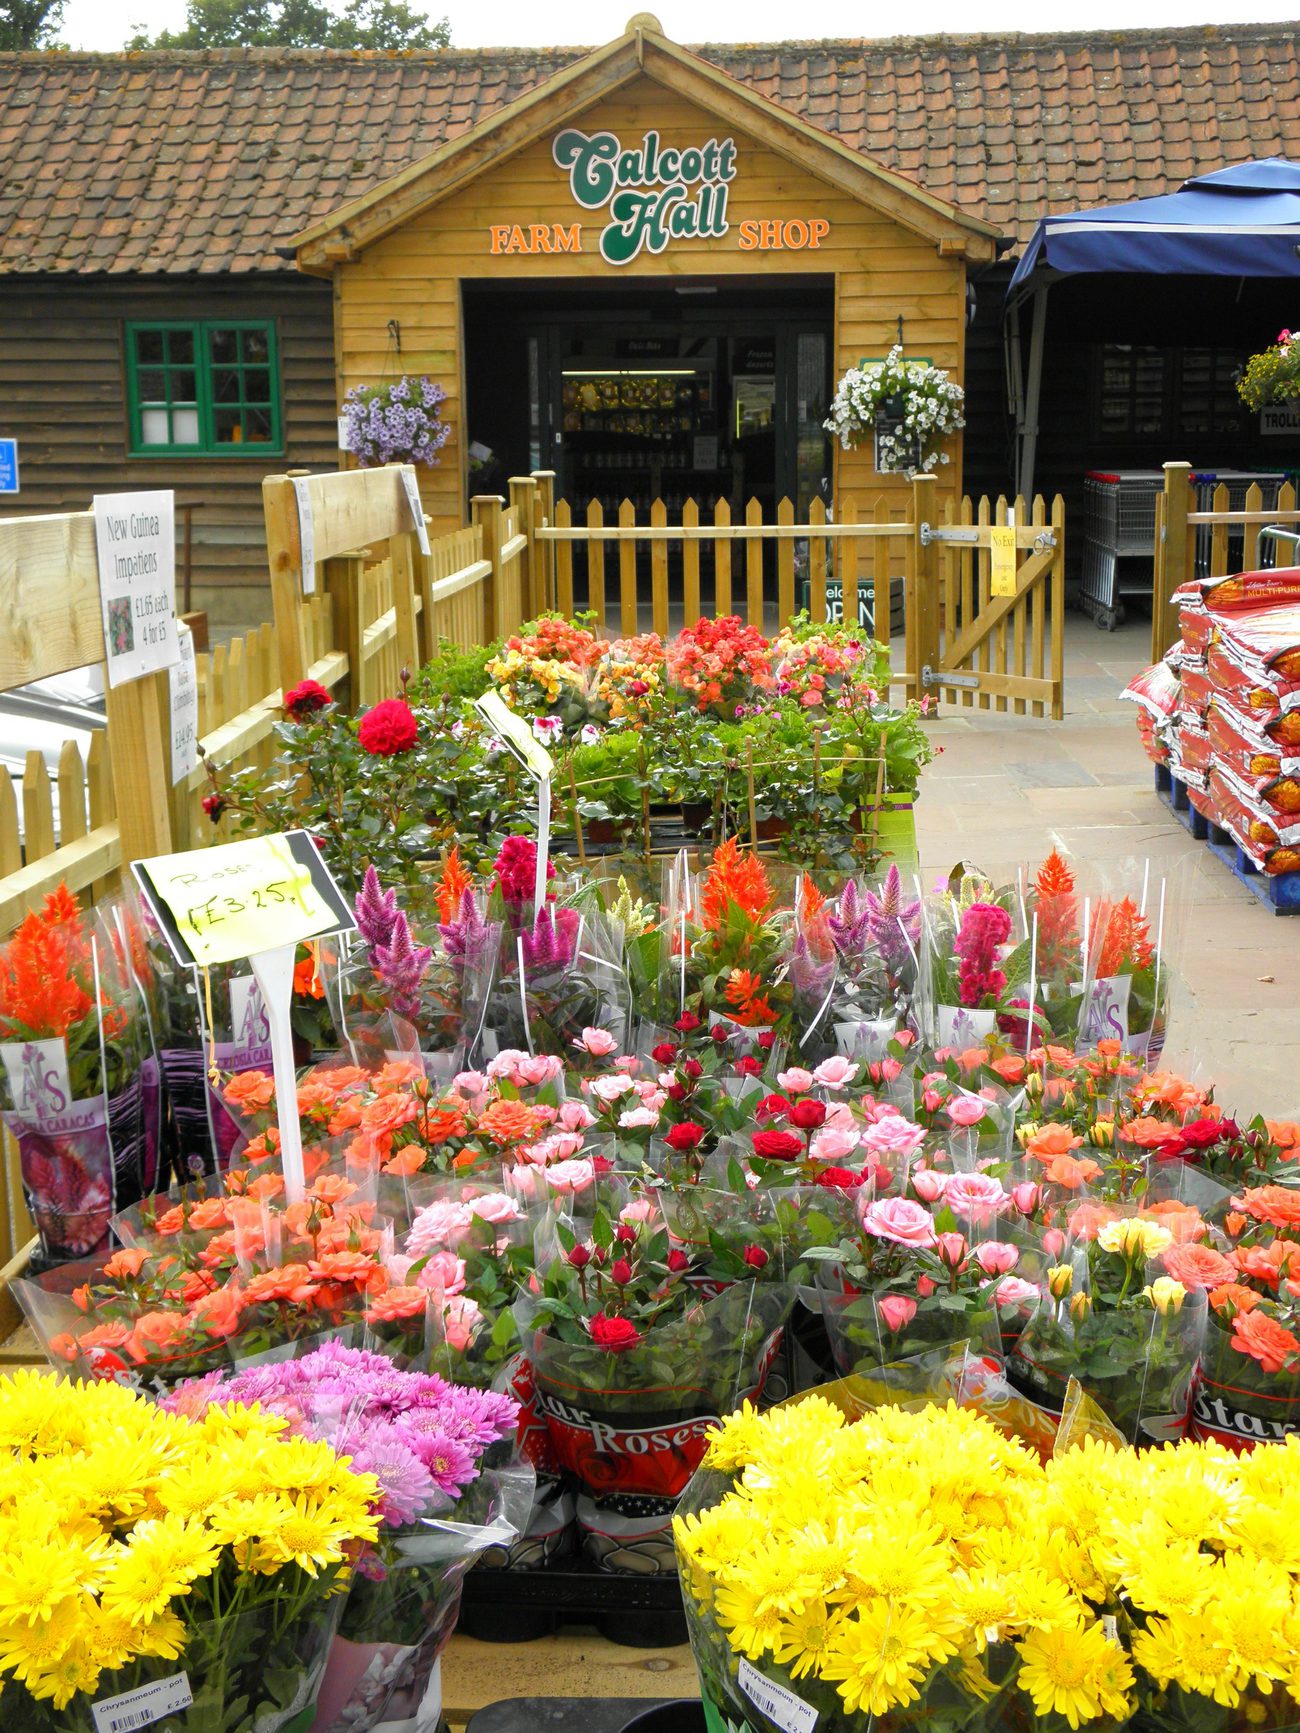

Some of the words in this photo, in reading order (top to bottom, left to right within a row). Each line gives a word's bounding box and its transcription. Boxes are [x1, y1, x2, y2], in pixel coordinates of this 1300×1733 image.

[553, 129, 737, 209] Calcott
[490, 224, 582, 254] FARM
[600, 183, 729, 265] Hall
[738, 219, 830, 250] SHOP
[107, 515, 128, 542] New
[130, 512, 160, 539] Guinea
[114, 550, 158, 584] Impatiens
[136, 595, 154, 618] £1.65
[155, 590, 169, 612] each
[1247, 585, 1300, 598] MULTI-PUR
[143, 625, 148, 646] 4
[591, 1418, 707, 1454] Roses
[169, 1678, 183, 1689] pot
[799, 1705, 811, 1717] pot
